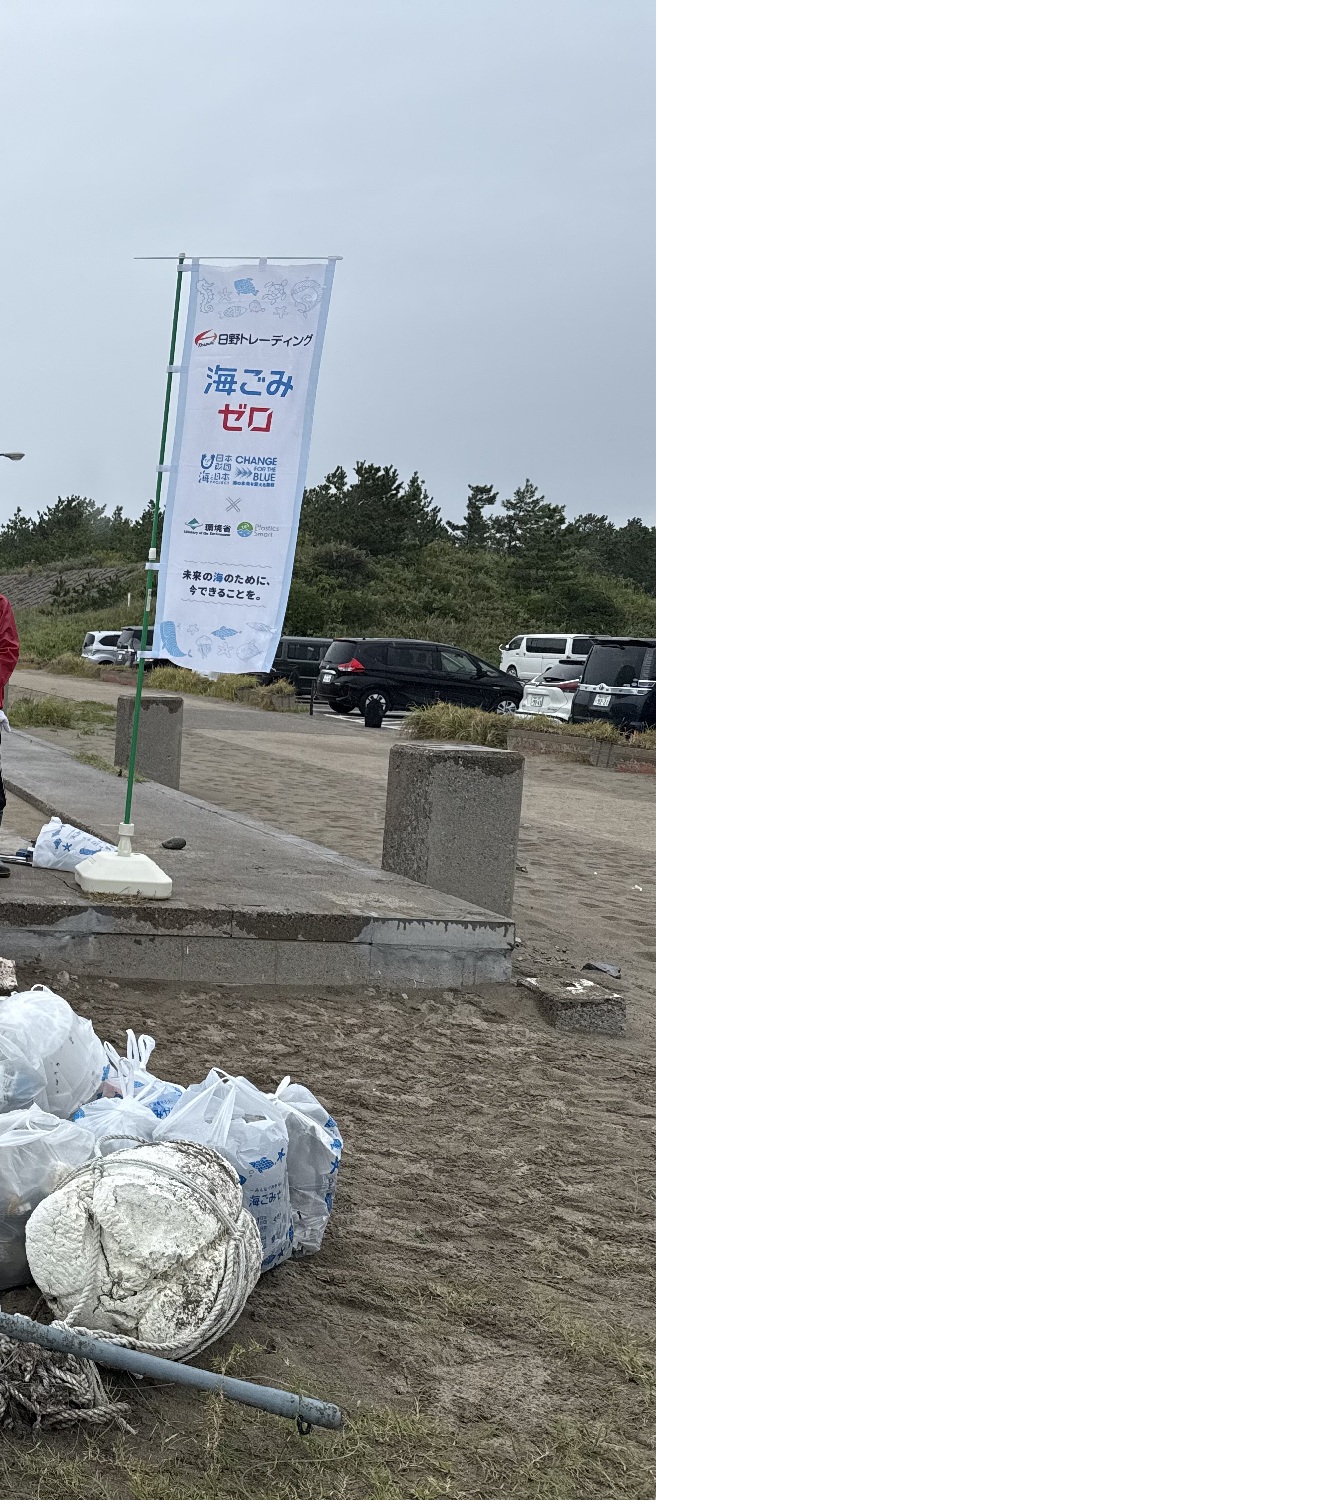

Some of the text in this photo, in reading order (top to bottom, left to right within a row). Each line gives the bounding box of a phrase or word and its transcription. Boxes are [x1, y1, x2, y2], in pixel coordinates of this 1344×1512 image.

[218, 332, 314, 347] 日野トレーディング
[204, 364, 294, 398] 海ごみ
[218, 403, 274, 433] ゼロ
[215, 454, 233, 462] 日本
[235, 455, 278, 466] CHANGE
[252, 472, 276, 482] BLUE
[205, 523, 232, 533] 環境省
[254, 523, 279, 531] Plastics
[182, 569, 271, 586] 未来の海のために、
[189, 584, 261, 601] 今できることを。
